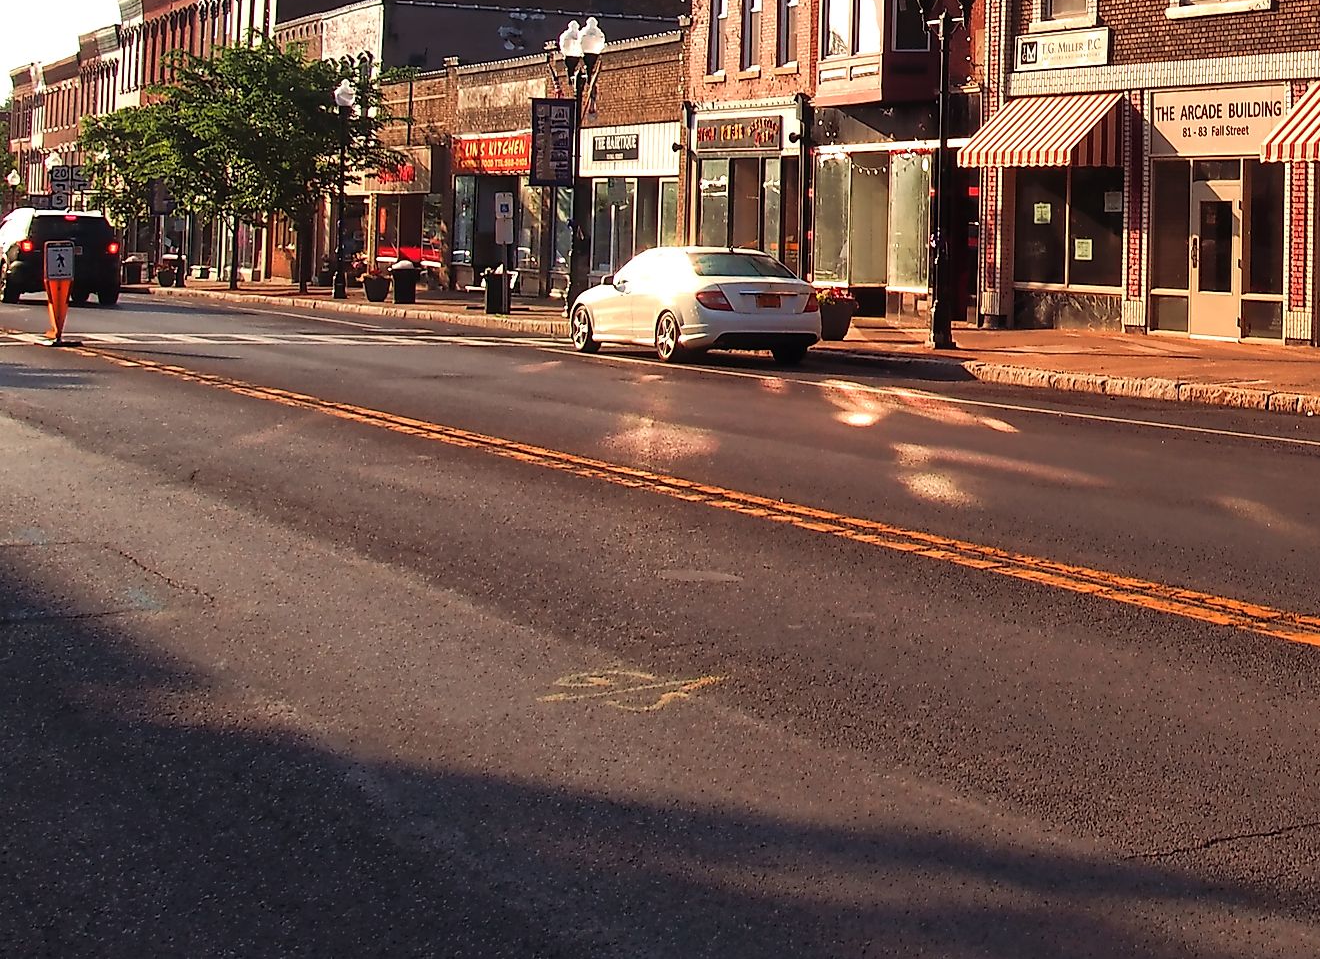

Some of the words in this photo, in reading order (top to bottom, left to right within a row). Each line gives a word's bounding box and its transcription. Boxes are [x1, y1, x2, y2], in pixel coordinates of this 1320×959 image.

[1155, 106, 1175, 122] THE
[1180, 104, 1223, 120] ARCADE
[1228, 101, 1282, 118] BUILDING
[1182, 127, 1192, 138] 81
[1198, 126, 1208, 137] 83
[1212, 125, 1224, 136] Fall
[1226, 125, 1250, 136] Street
[465, 141, 486, 157] LINS
[488, 138, 526, 156] KITCHEN
[595, 136, 606, 150] THE
[54, 168, 67, 178] 20
[56, 196, 63, 204] 5
